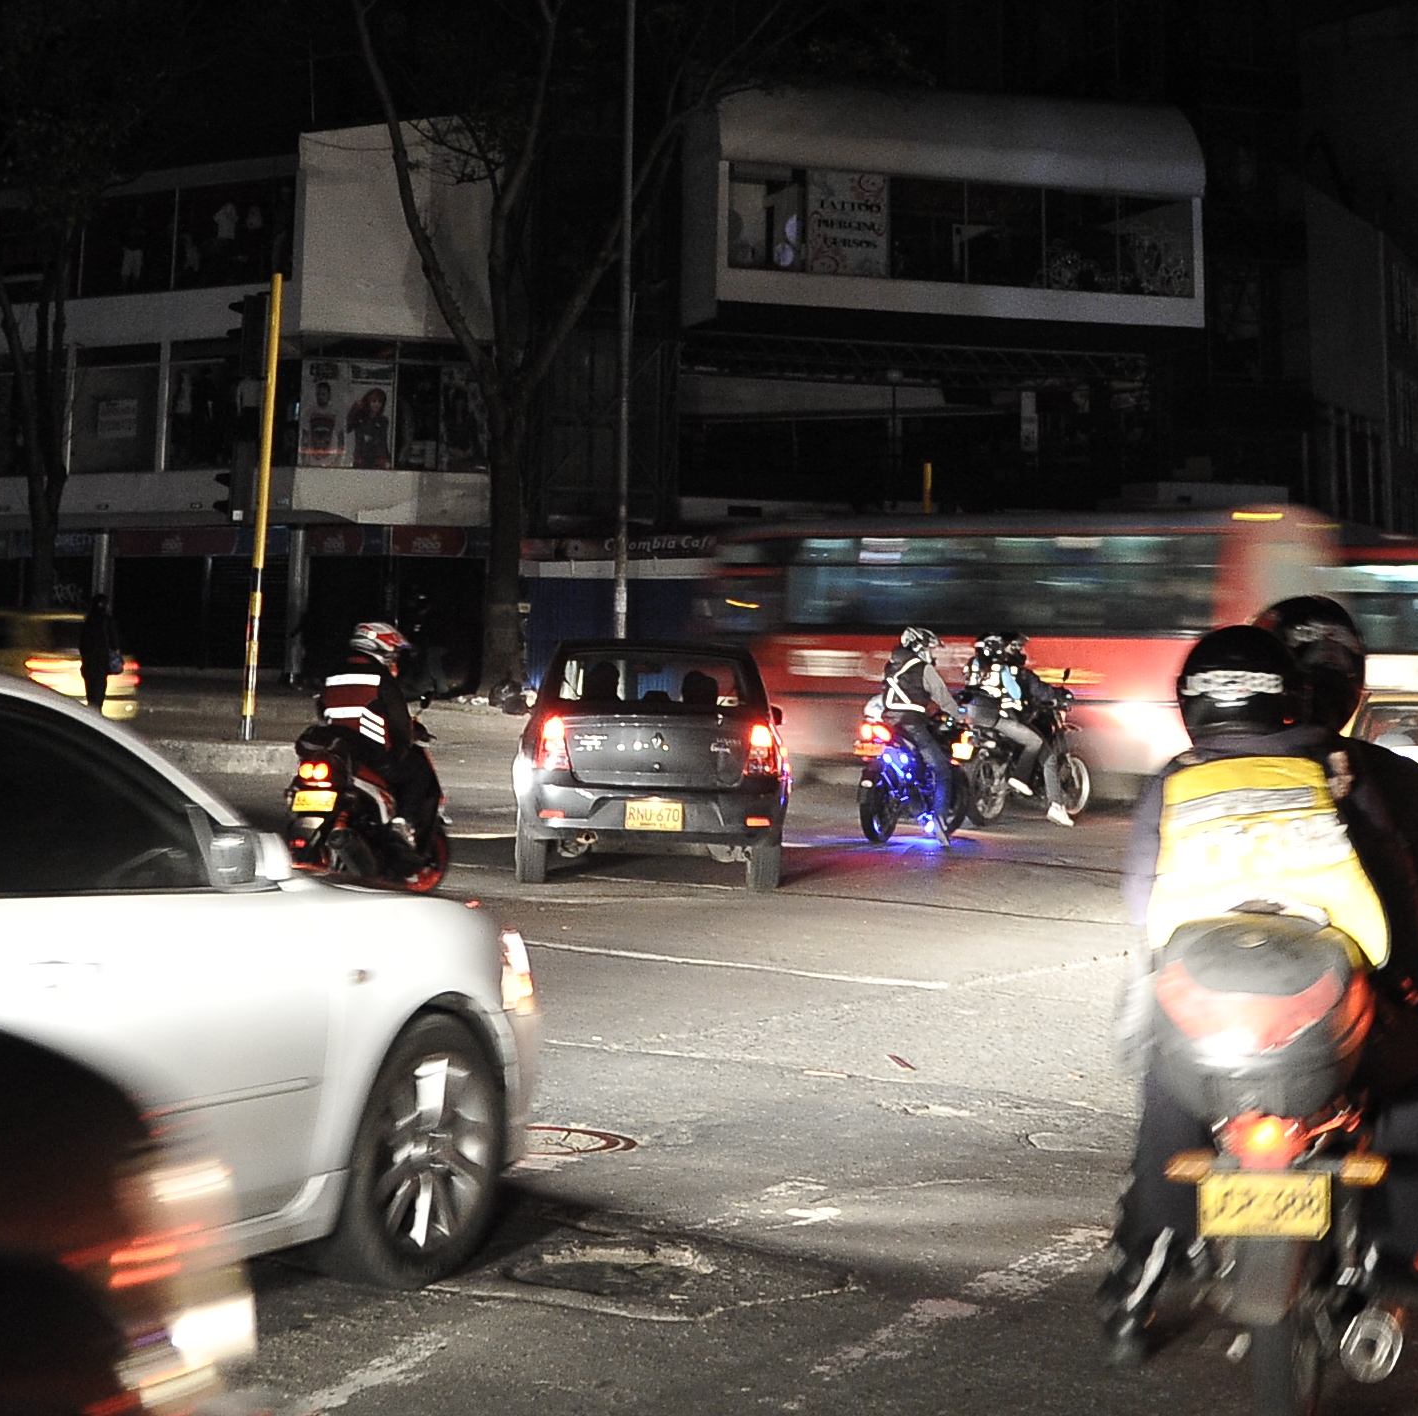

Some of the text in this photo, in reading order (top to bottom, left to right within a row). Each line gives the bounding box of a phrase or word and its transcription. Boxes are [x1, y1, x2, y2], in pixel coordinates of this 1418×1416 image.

[819, 199, 882, 214] TATTOO
[823, 236, 878, 249] CURSOS
[603, 537, 676, 553] Combia
[628, 806, 680, 823] RNU-670
